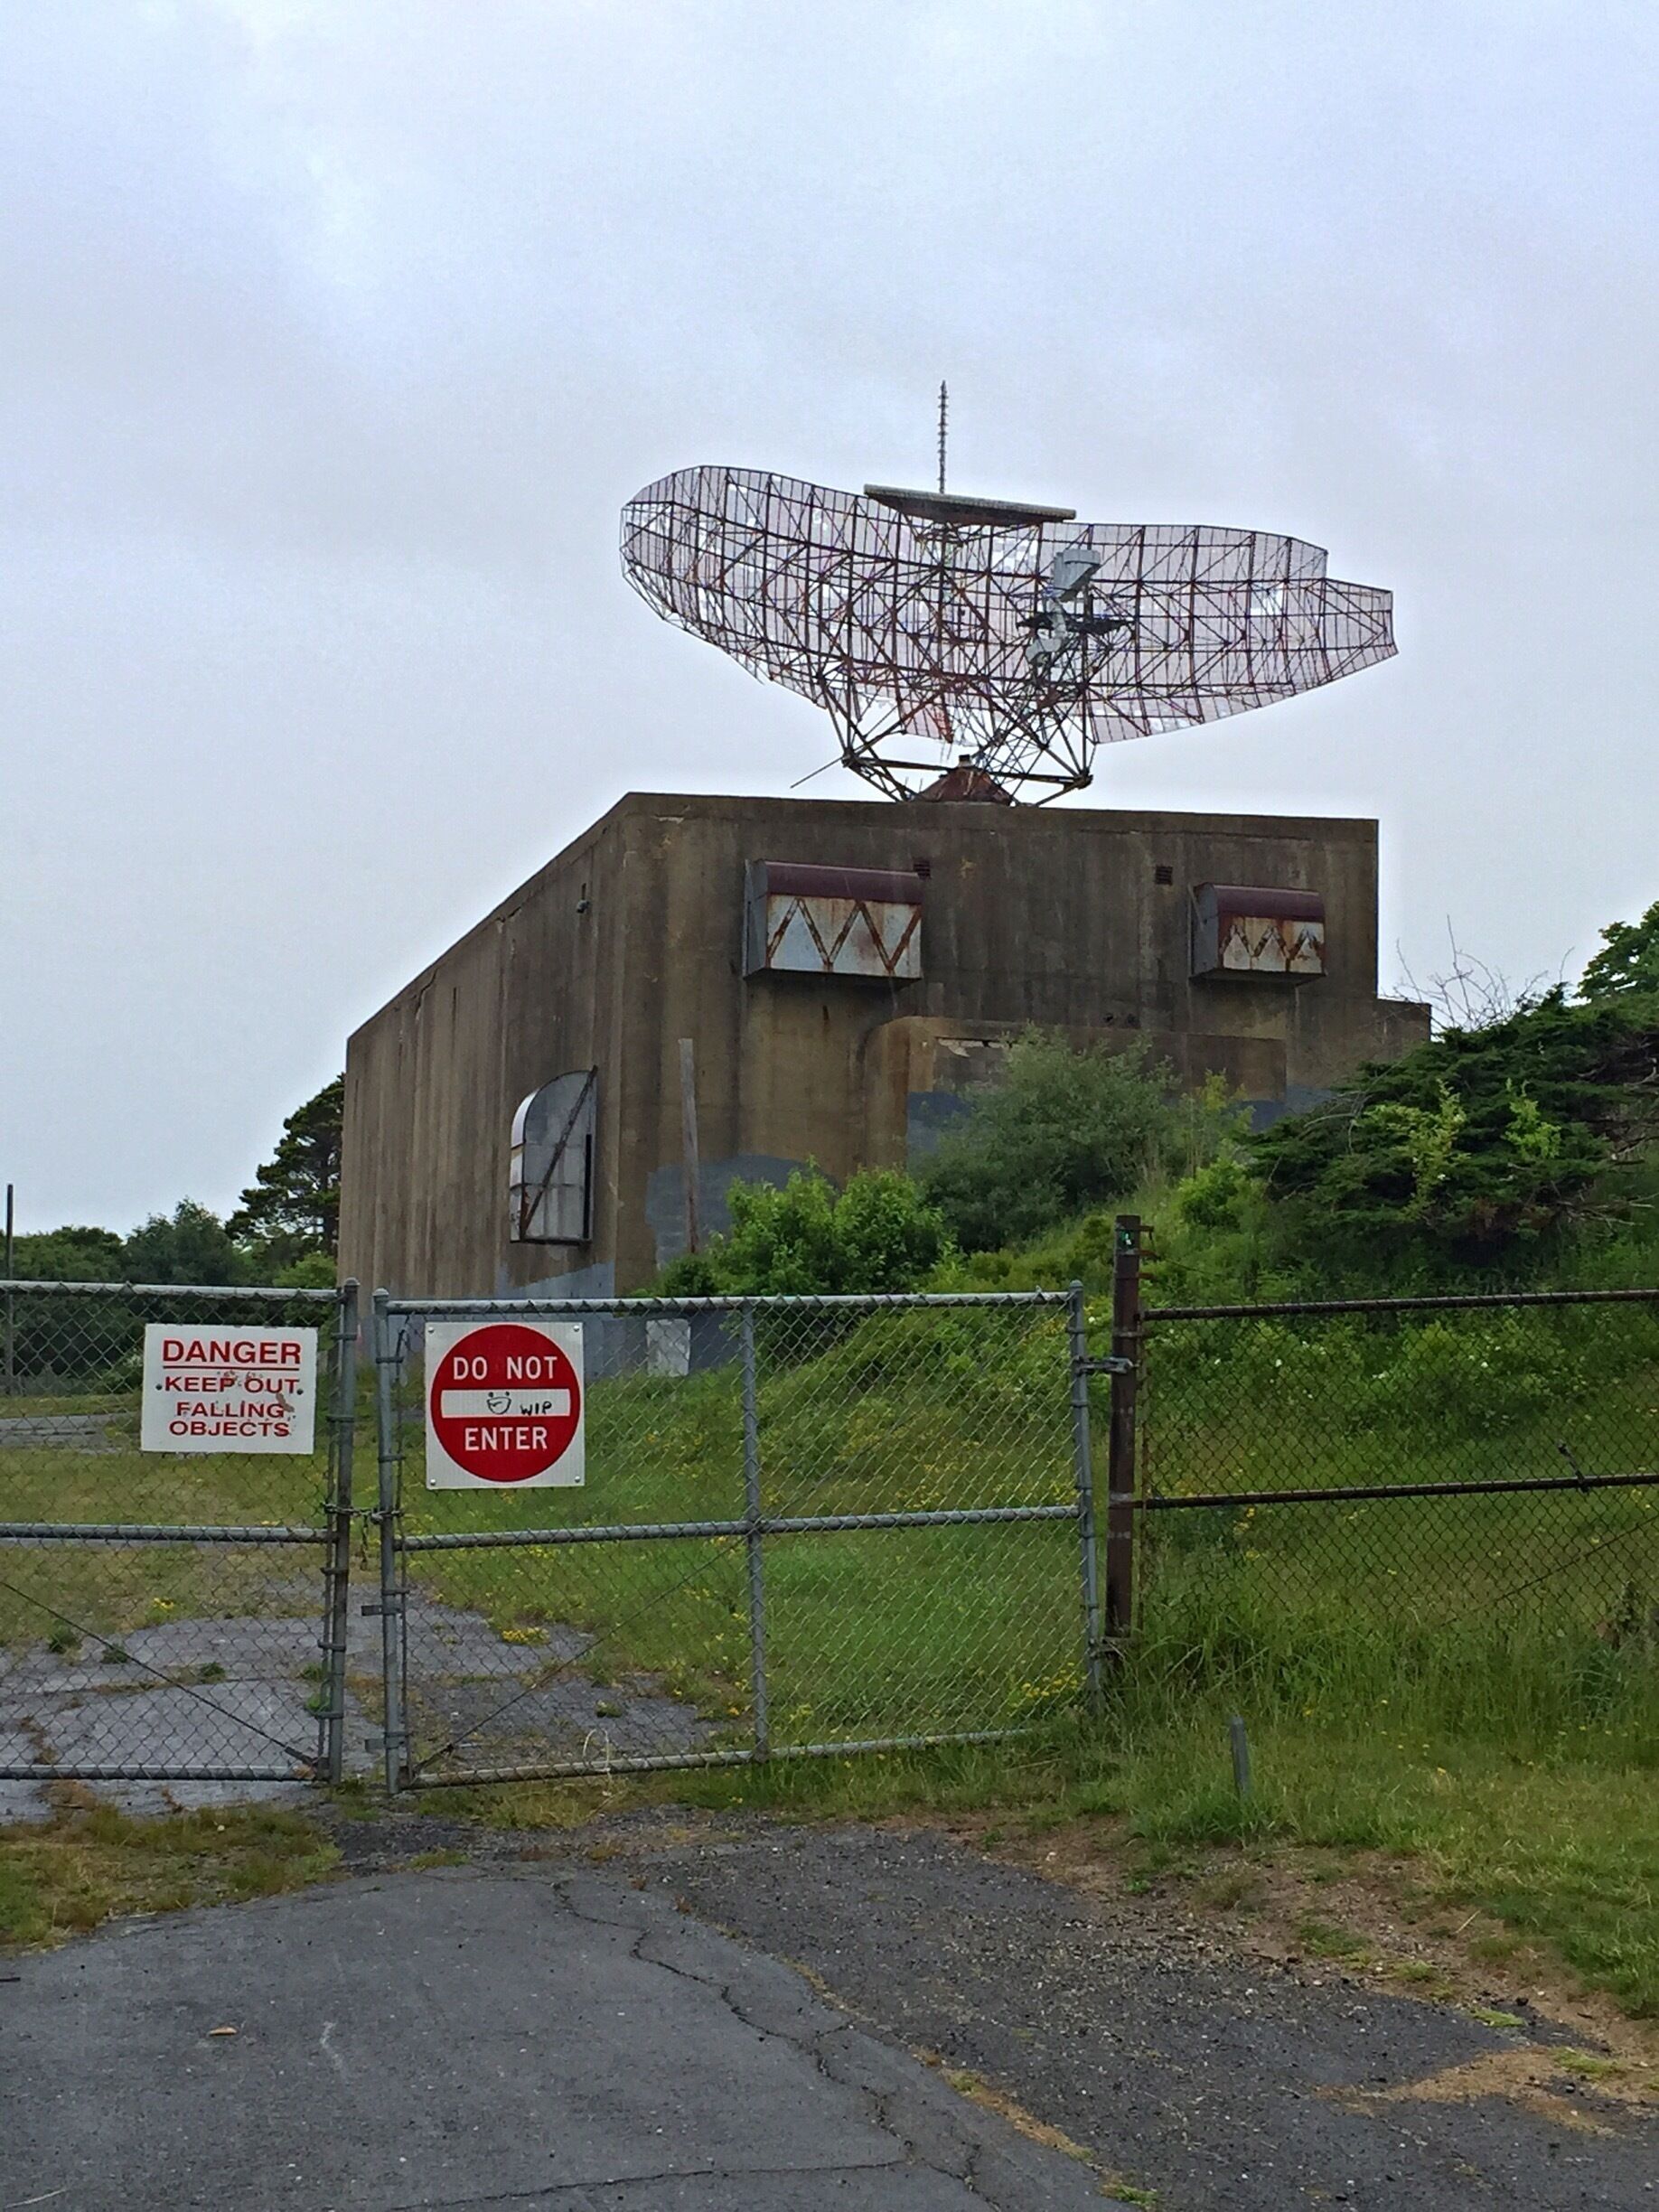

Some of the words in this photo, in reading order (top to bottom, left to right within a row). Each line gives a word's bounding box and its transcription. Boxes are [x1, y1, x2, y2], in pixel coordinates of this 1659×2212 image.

[163, 1340, 301, 1364] DANGER
[454, 1356, 488, 1380] DO
[506, 1356, 558, 1380] NOT
[164, 1376, 235, 1392] KEEP
[244, 1378, 300, 1394] OUT
[176, 1401, 285, 1418] FALLING
[169, 1421, 290, 1437] OBJECTS
[464, 1427, 548, 1451] ENTER
